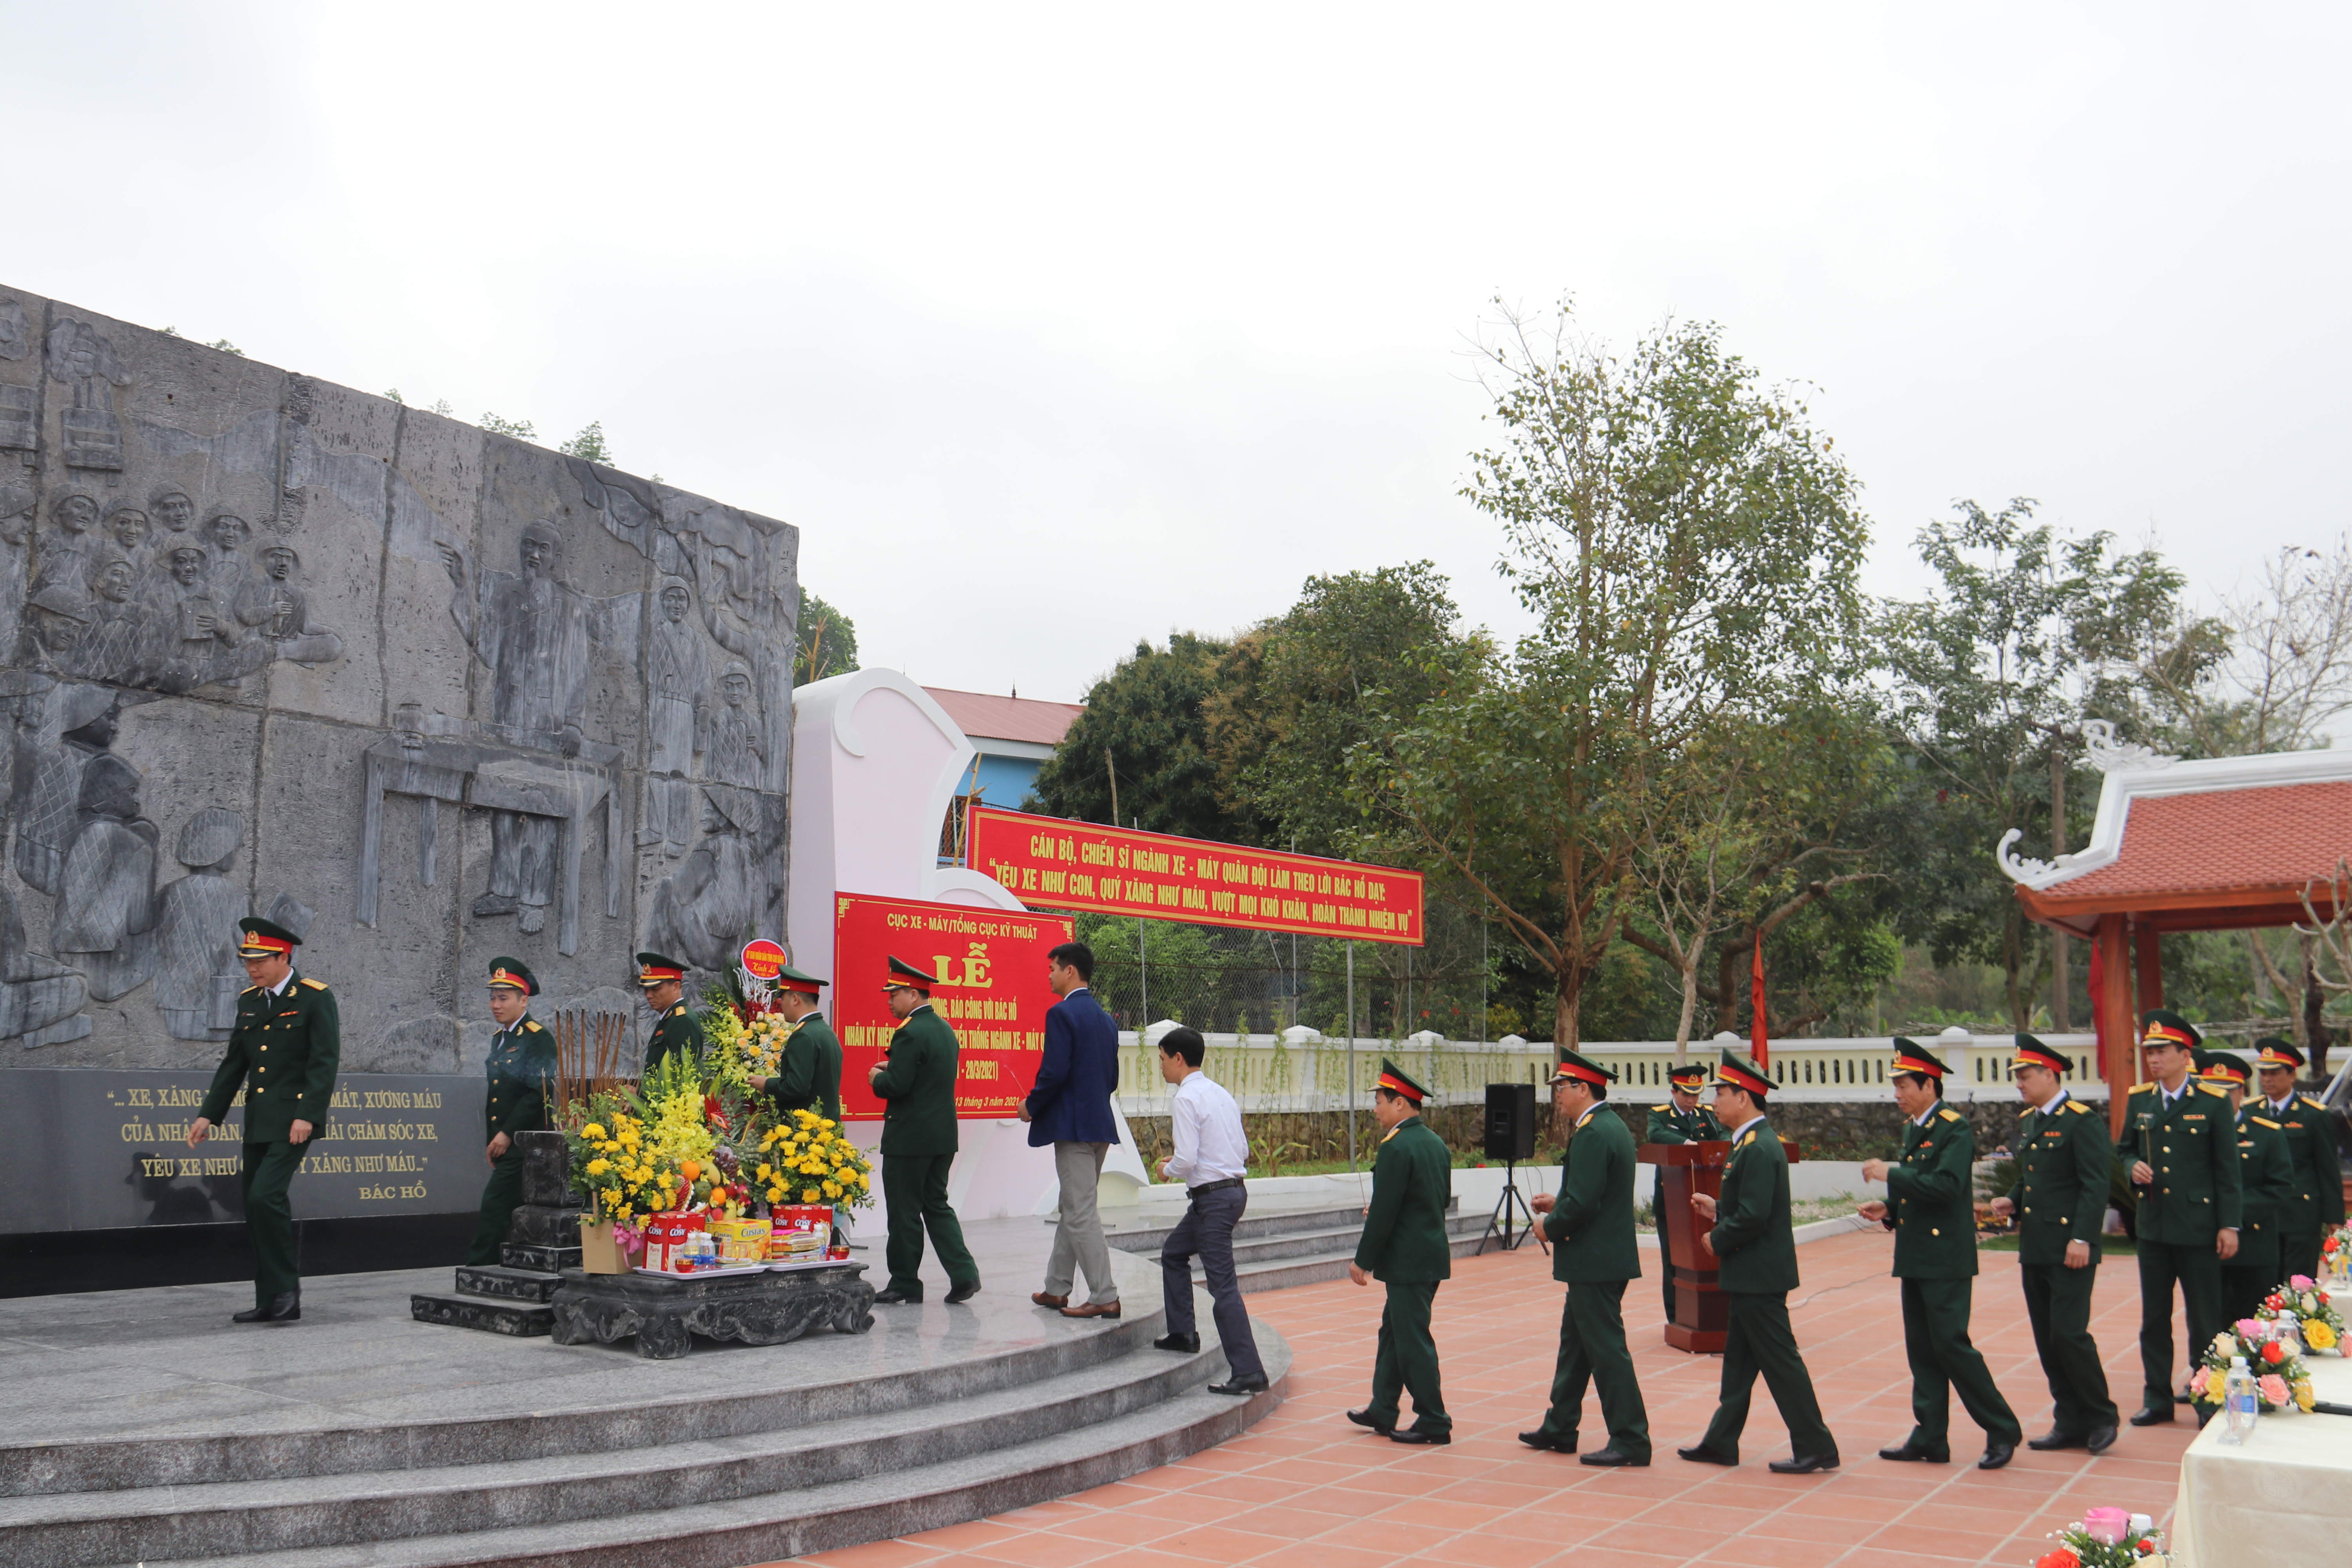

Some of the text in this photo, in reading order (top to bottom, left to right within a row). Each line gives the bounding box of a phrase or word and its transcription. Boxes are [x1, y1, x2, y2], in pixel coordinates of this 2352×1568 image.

[1031, 832, 1054, 859] CÁN
[1058, 835, 1077, 866] BỘ,
[1082, 838, 1114, 867] CHIẾN
[1118, 847, 1129, 869] SĨ
[1133, 848, 1169, 875] NGÀNH
[1172, 855, 1185, 876] XE
[1197, 856, 1219, 880] MÁY
[1222, 860, 1248, 884] QUÂN
[1251, 863, 1267, 890] ĐỘI
[1270, 865, 1290, 889] LÀM
[1293, 871, 1315, 893] THEO
[1318, 871, 1331, 895] LỜI
[1334, 874, 1351, 897] BÁC
[1354, 875, 1365, 899] HỒ
[1368, 882, 1385, 904] DẠY:
[1022, 867, 1037, 891] XE
[1041, 870, 1067, 893] NHƯ
[1069, 873, 1095, 900] CON,
[1100, 875, 1121, 901] QUÝ
[1125, 877, 1154, 904] XĂNG
[1158, 884, 1180, 907] NHƯ
[1183, 884, 1208, 912] MÁU,
[1212, 890, 1236, 916] VƯỢT
[1239, 894, 1257, 919] MỌI
[1261, 895, 1279, 918] KHÓ
[1282, 897, 1309, 923] KHĂN,
[1312, 900, 1336, 924] HOÀN
[1339, 904, 1366, 927] THÀNH
[1369, 910, 1395, 933] NHIỆM
[1397, 909, 1412, 935] VỤ”
[887, 913, 908, 931] CỤC
[910, 915, 922, 929] XE
[929, 913, 977, 934] MÁY/TỔNG
[979, 922, 998, 939] CỤC
[1000, 922, 1011, 937] KỸ
[1012, 924, 1037, 943] THUẬT
[932, 942, 993, 988] LỄ
[927, 995, 1017, 1021] ƯƠNG, BÁO CÔNG VỚI BÁC HỒ
[845, 1022, 865, 1046] NHÂN
[866, 1020, 876, 1047] KỶ
[968, 1024, 989, 1049] THỐNG
[990, 1027, 1011, 1050] NGÀNH
[1013, 1031, 1021, 1050] XE
[1026, 1028, 1039, 1050] MÁY
[965, 1060, 998, 1081] 28/3/2021)
[128, 1089, 154, 1109] XE,
[157, 1085, 202, 1107] XĂNG
[330, 1082, 362, 1110] MẮT,
[364, 1090, 410, 1108] XƯƠNG
[412, 1089, 441, 1109] MÁU
[955, 1096, 1019, 1109] 13 tháng 3 năm 2021
[121, 1115, 155, 1142] CỦA
[158, 1118, 188, 1141] NHÂ
[347, 1119, 385, 1140] CHĂM
[388, 1120, 414, 1140] SÓC
[417, 1124, 438, 1142] XE,
[141, 1153, 174, 1177] YÊU
[178, 1158, 201, 1176] XE
[203, 1156, 238, 1176] NHƯ
[310, 1152, 352, 1173] XĂNG
[354, 1154, 383, 1172] NHƯ
[359, 1180, 427, 1200] BÁC HỒ
[741, 1227, 766, 1237] Custas
